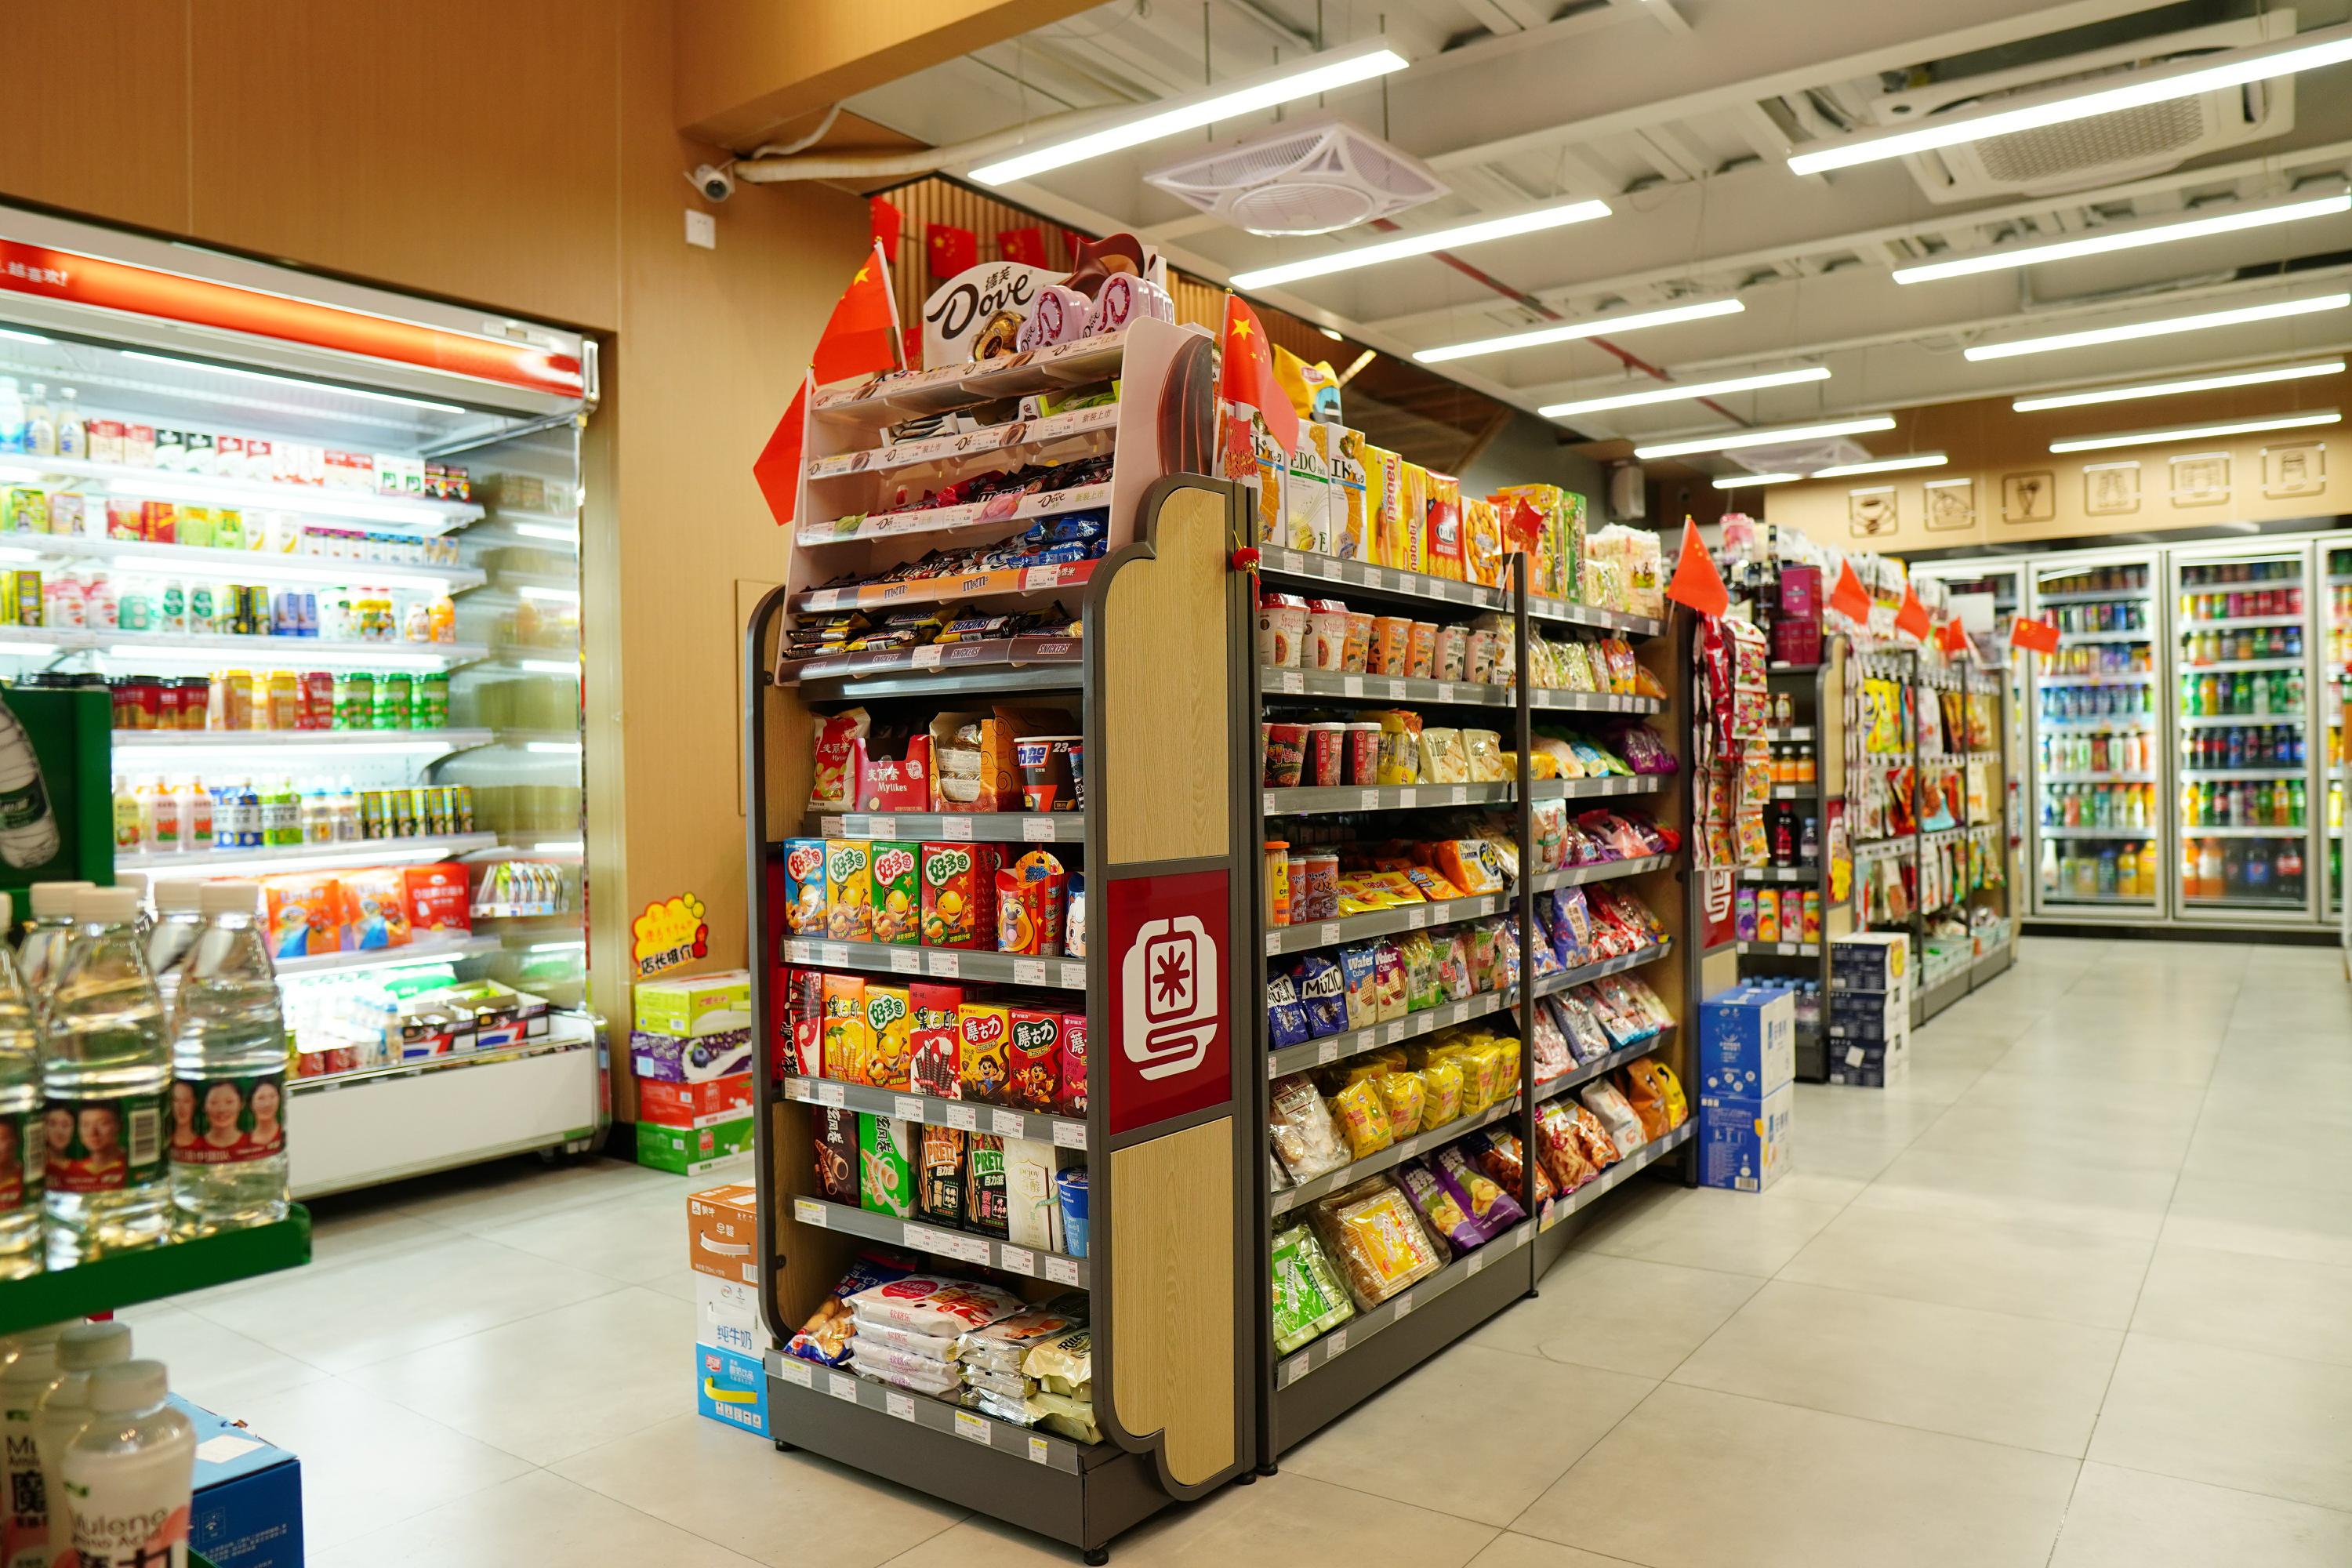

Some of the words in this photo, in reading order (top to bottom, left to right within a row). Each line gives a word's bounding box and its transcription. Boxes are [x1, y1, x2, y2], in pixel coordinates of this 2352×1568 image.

[927, 274, 1035, 339] Dove
[1250, 434, 1282, 463] ドパック
[1038, 492, 1066, 508] Dove
[1386, 458, 1396, 522] nabati
[952, 647, 981, 658] SNICKERS
[1038, 644, 1069, 654] SNICKERS
[1052, 742, 1069, 753] 23
[877, 782, 907, 793] Mylikes
[790, 849, 821, 877] 好多鱼
[832, 851, 863, 880] 好多鱼
[877, 852, 912, 881] 好多鱼
[928, 854, 968, 883] 好多鱼
[1348, 954, 1373, 971] Wafer
[1352, 968, 1366, 978] Cube
[828, 994, 859, 1019] 黑白配
[871, 998, 902, 1025] 好多鱼
[914, 1006, 956, 1033] 黑白配
[966, 1018, 1000, 1042] 蘑古力
[1017, 1022, 1054, 1047] 蘑古力
[927, 1142, 955, 1162] PRETZ
[975, 1150, 1004, 1173] PRETZ
[936, 1166, 955, 1176] 百力滋
[984, 1176, 1004, 1186] 百力滋
[717, 1324, 753, 1351] 纯牛奶
